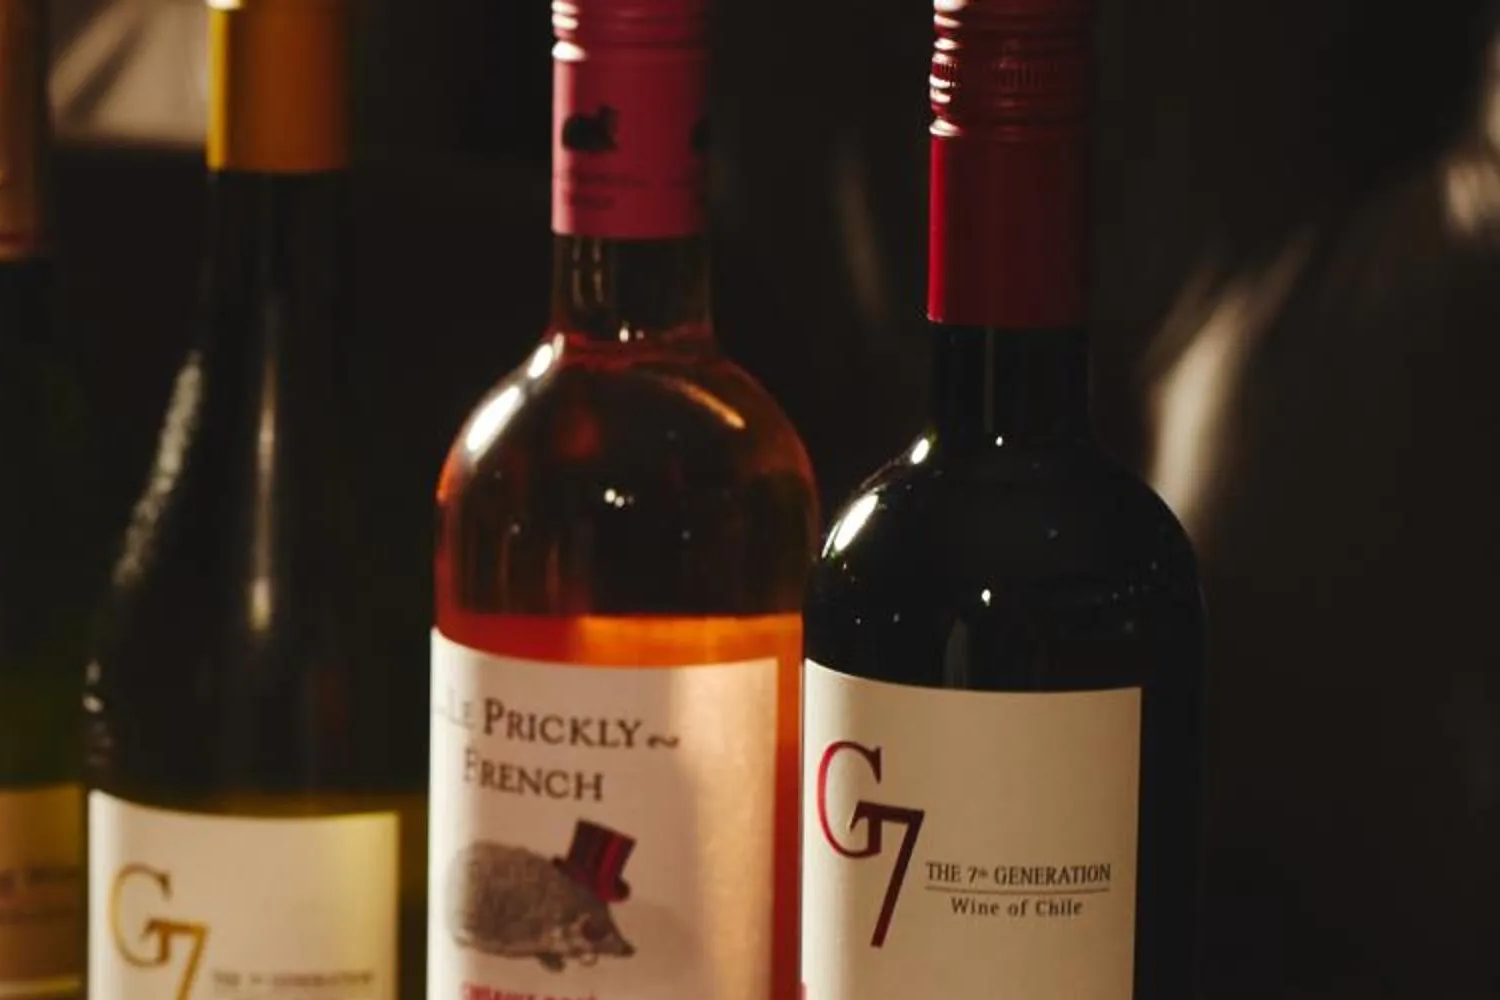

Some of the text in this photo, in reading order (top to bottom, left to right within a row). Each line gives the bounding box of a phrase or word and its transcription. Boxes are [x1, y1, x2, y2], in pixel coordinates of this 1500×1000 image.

[484, 697, 644, 750] PRICKLY
[464, 746, 604, 802] FRENCH
[816, 740, 926, 949] G7
[925, 861, 961, 883] THE
[994, 863, 1112, 886] GENERATION
[950, 897, 1084, 918] Wine of Chile
